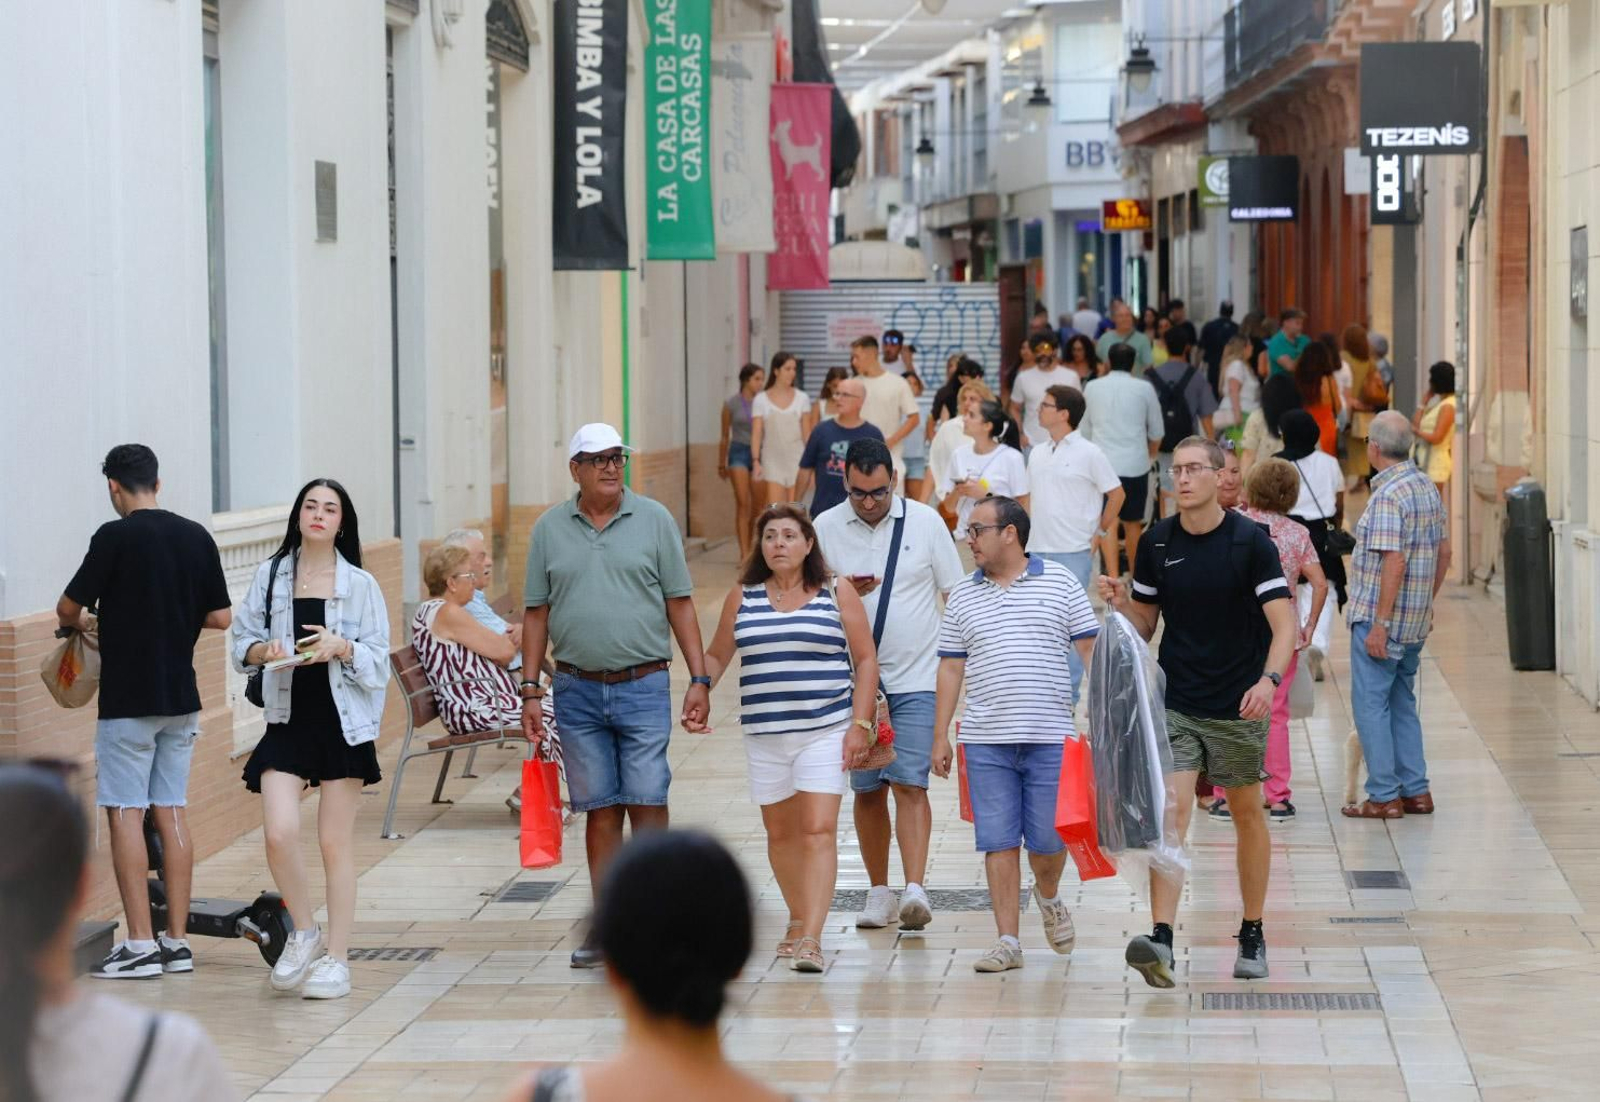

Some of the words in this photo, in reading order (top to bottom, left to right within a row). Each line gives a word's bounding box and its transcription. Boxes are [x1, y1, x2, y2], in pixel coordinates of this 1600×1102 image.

[656, 54, 677, 93] DE
[576, 96, 602, 120] Y
[657, 98, 678, 173] CASA
[681, 33, 703, 182] CARCASAS
[576, 126, 603, 209] LOLA
[657, 182, 678, 222] LA
